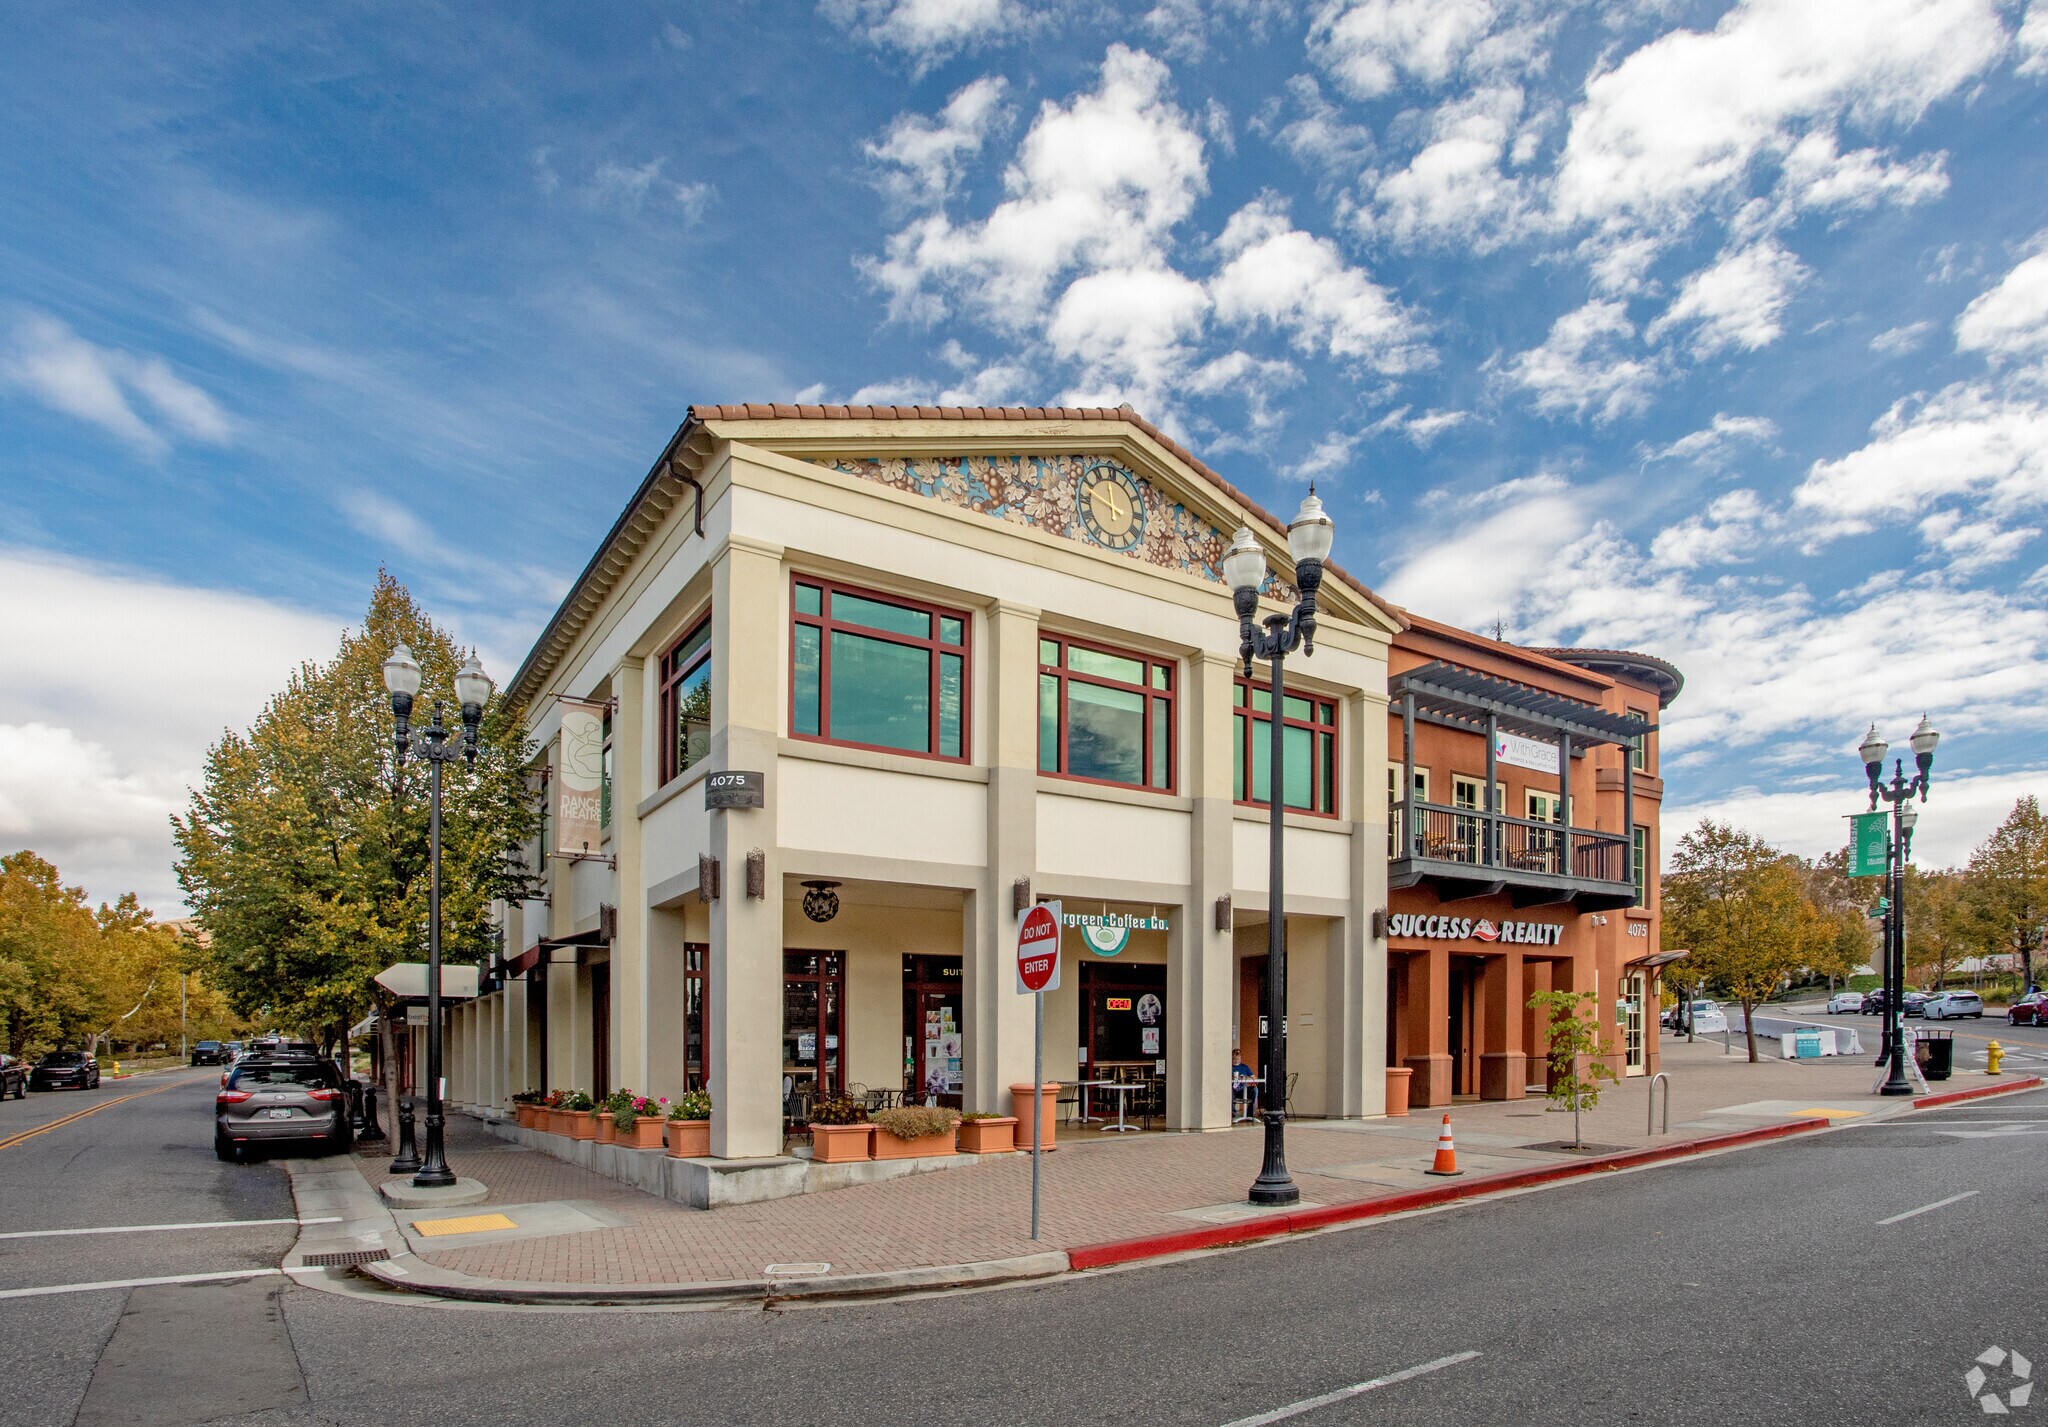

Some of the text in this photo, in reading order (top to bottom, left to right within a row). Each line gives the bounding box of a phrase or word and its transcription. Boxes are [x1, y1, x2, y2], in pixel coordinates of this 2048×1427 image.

[1509, 738, 1557, 763] WithGrace
[711, 775, 745, 787] 4075
[561, 794, 601, 811] DANCE
[560, 805, 601, 822] THEATRE
[1848, 818, 1858, 874] EVERGREEN
[1060, 912, 1169, 931] rgreen Coffee Co.
[1388, 913, 1564, 945] SUCCESS REALTY
[1627, 923, 1647, 937] 4075
[1024, 922, 1052, 940] DO NOT
[943, 968, 963, 976] SUIT
[1024, 959, 1049, 974] ENTER
[1109, 999, 1131, 1009] OPEN
